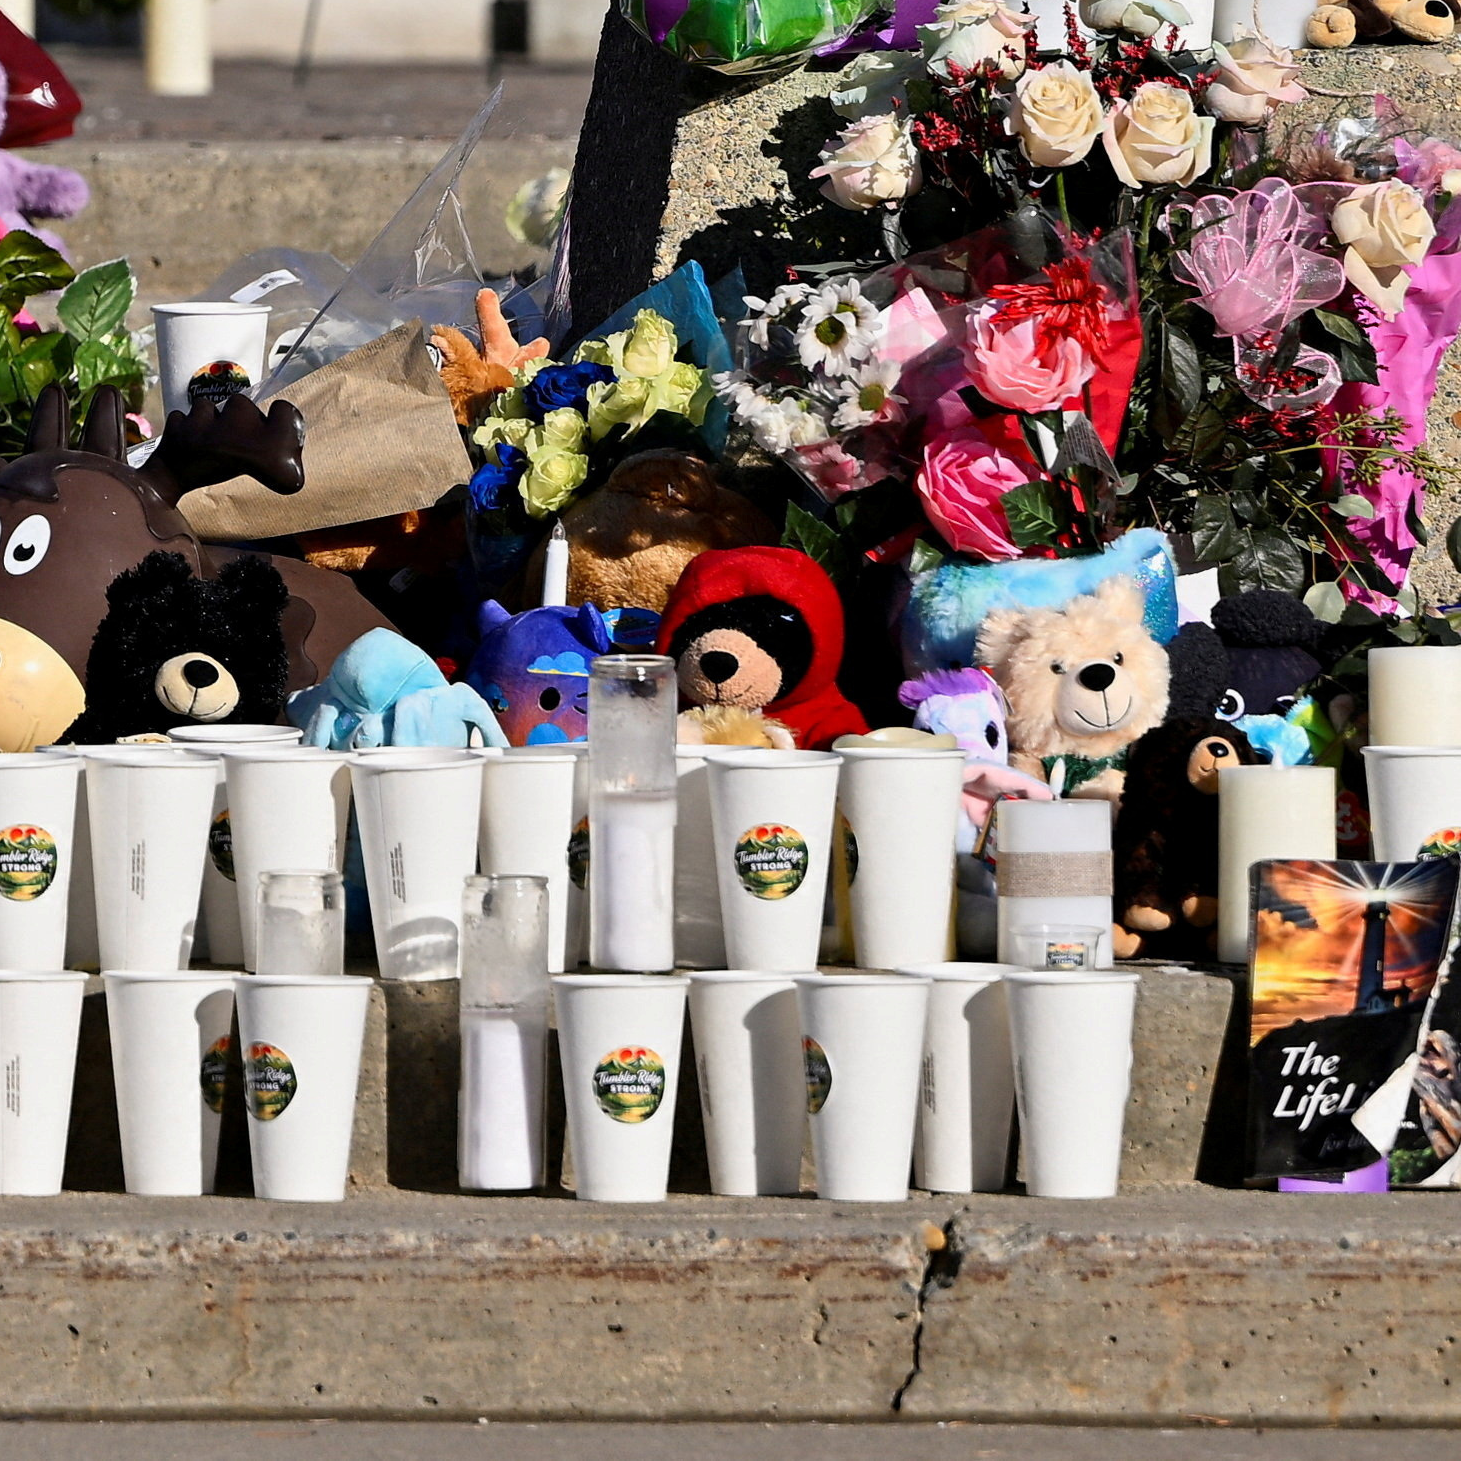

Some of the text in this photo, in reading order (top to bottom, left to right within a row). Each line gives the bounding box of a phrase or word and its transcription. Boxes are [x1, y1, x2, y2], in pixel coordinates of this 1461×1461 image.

[26, 848, 54, 864] Ridge
[736, 846, 804, 863] Tumbler Ridge
[1, 863, 42, 872] STRONG
[750, 861, 792, 870] STRONG
[1280, 1041, 1341, 1076] The
[264, 1067, 291, 1085] Ridge
[596, 1069, 664, 1085] Tumbler Ridge
[610, 1084, 651, 1094] STRONG
[1272, 1076, 1375, 1132] LifeLi
